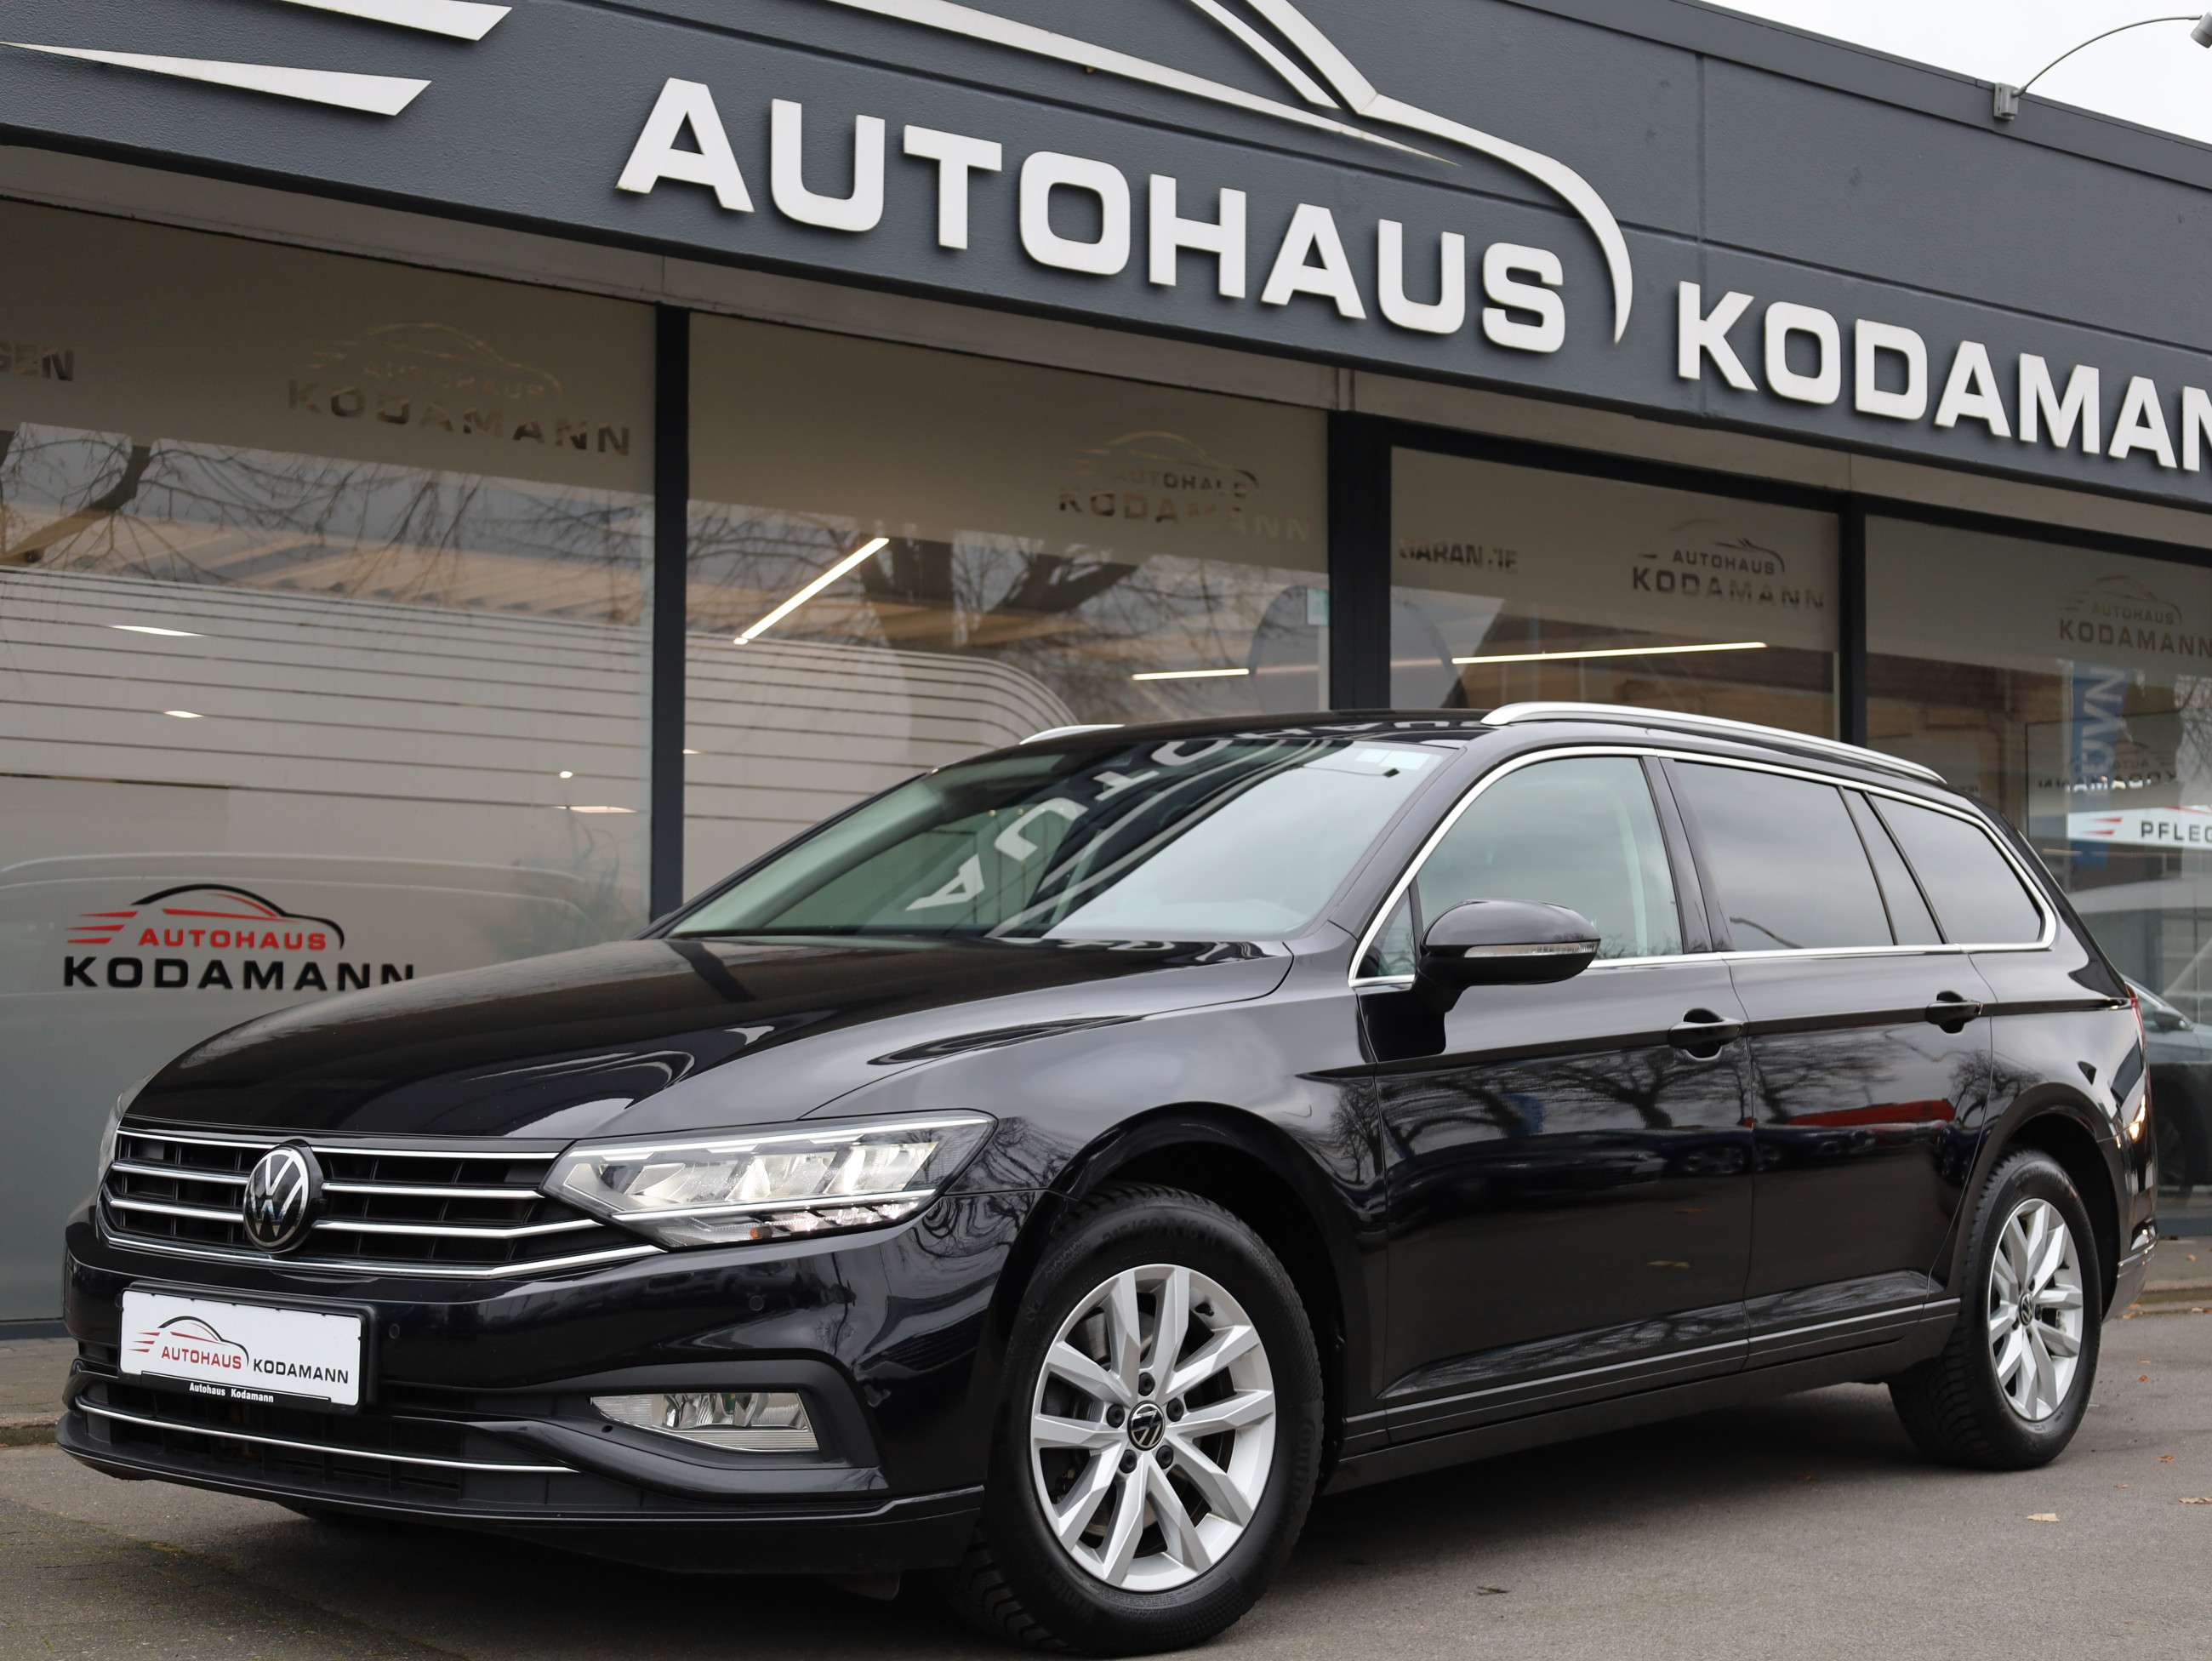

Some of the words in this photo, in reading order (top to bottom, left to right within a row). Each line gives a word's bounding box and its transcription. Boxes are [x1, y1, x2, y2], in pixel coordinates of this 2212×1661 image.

[615, 77, 1565, 353] AUTOHAUS
[1679, 281, 2212, 471] KODAMAN
[288, 379, 630, 456] KODAMANN
[1399, 539, 1518, 574] GARANIE
[1673, 549, 1775, 575] AUTOHAUS
[1633, 566, 1824, 609] KODAMANN
[2091, 602, 2175, 625] AUTOHAUS
[2060, 619, 2212, 657] KODAMANN
[139, 928, 327, 950] AUTOHAUS
[64, 956, 414, 992] KODAMANN
[162, 1346, 242, 1369] AUTOHAUS
[254, 1358, 348, 1384] KODAMANN
[190, 1382, 225, 1396] Autohaus
[231, 1389, 274, 1403] Kodamann
